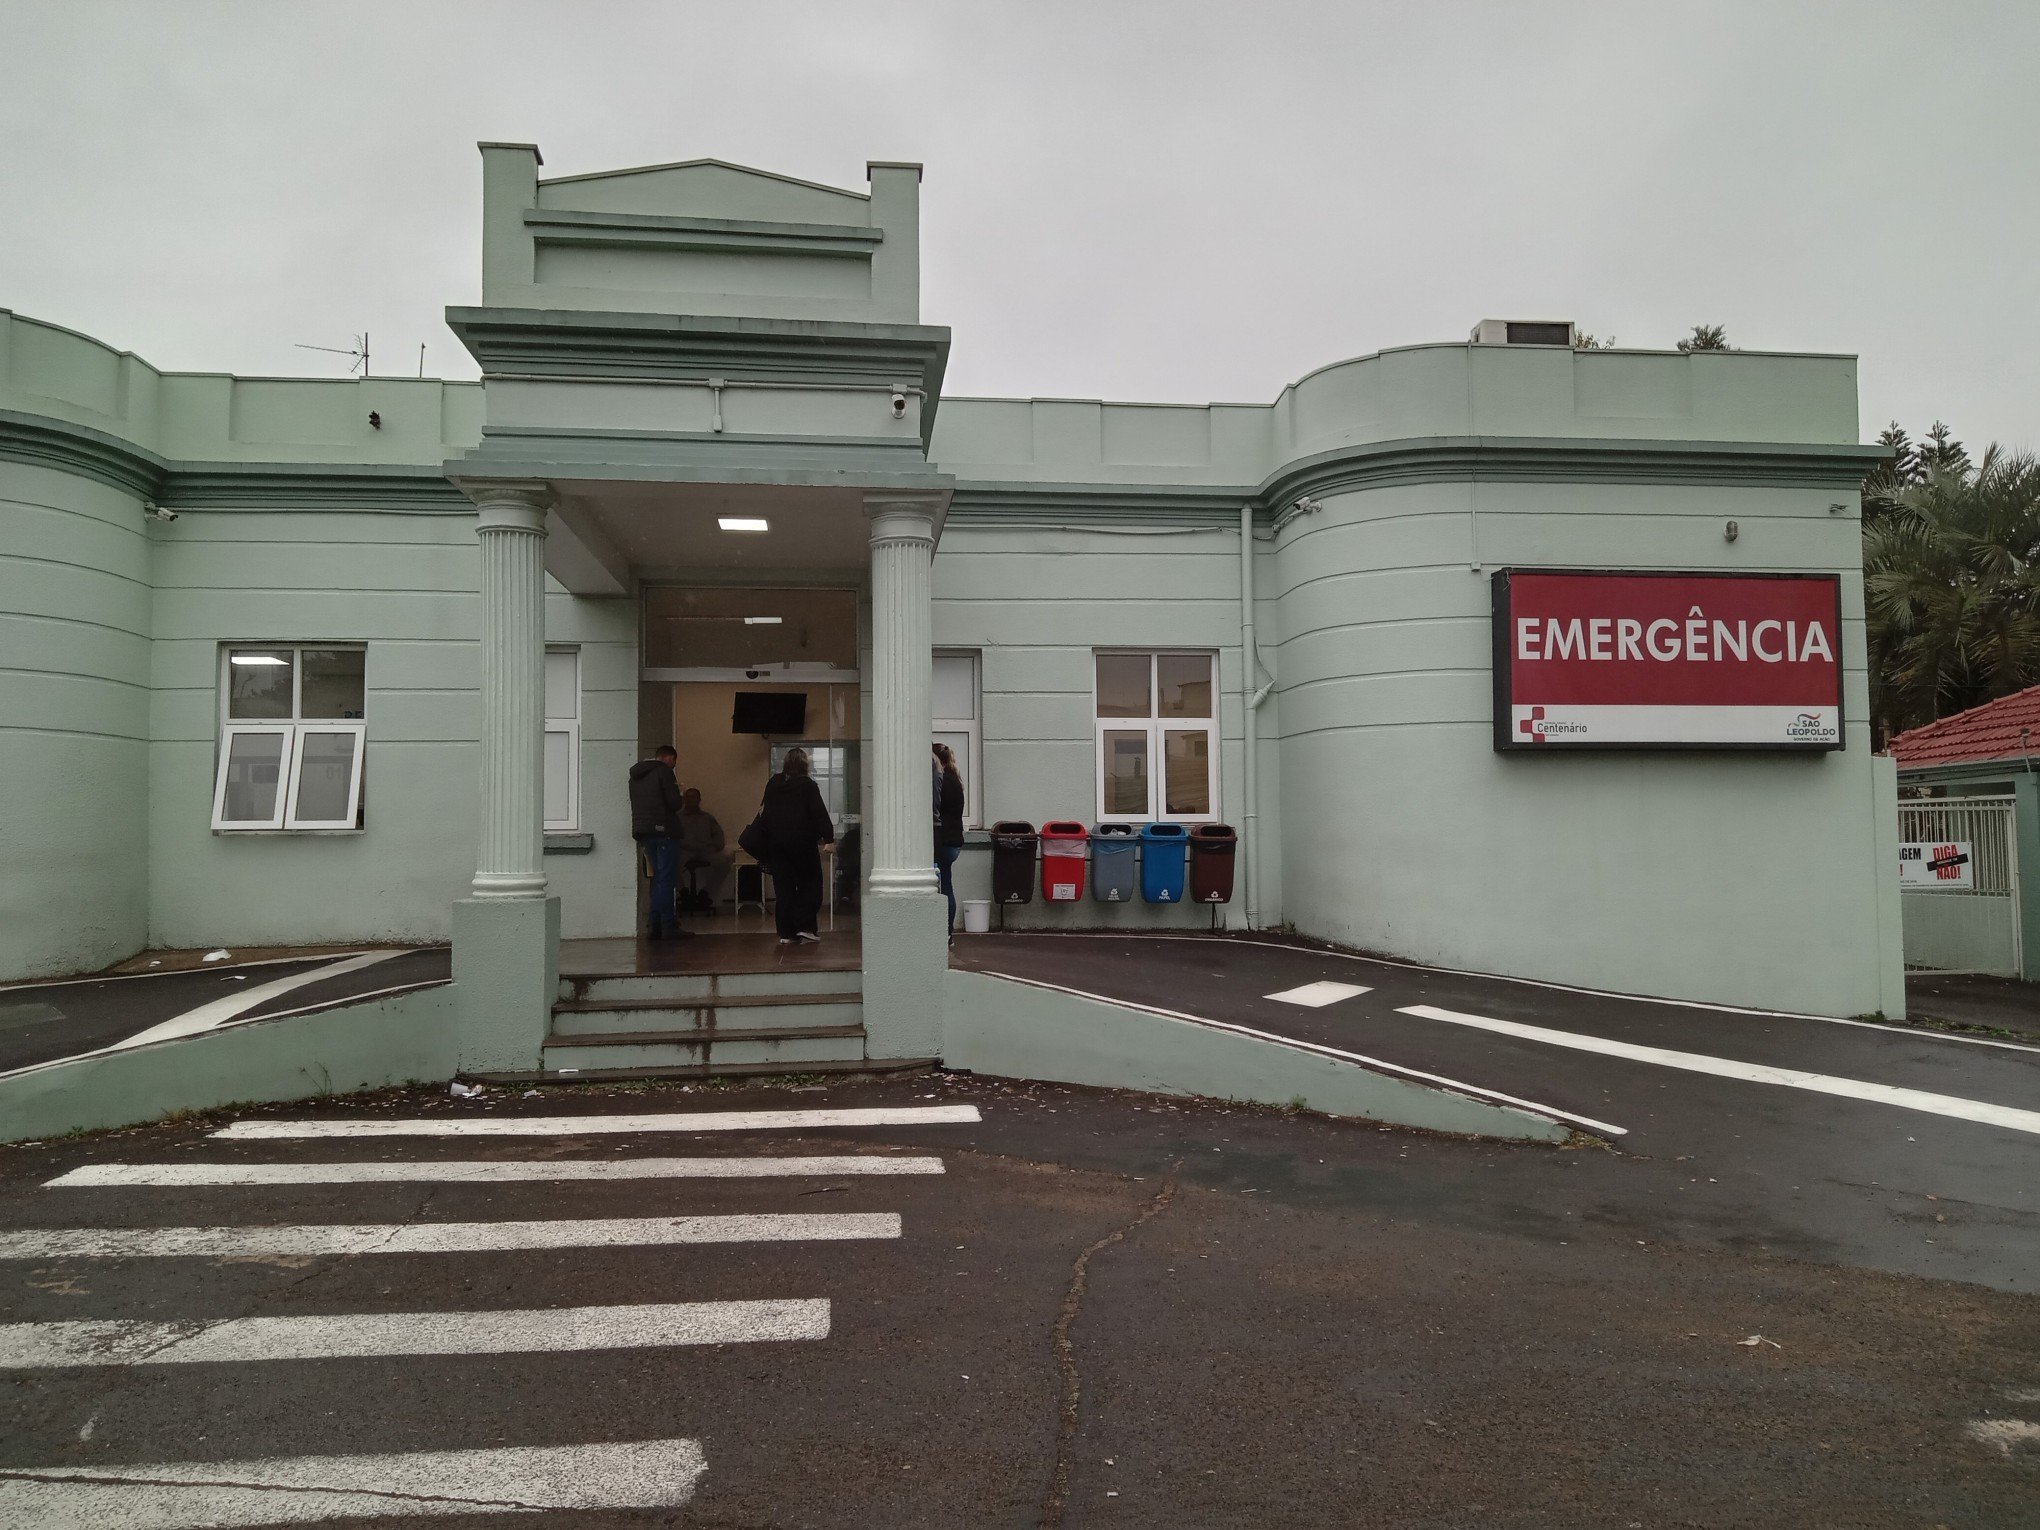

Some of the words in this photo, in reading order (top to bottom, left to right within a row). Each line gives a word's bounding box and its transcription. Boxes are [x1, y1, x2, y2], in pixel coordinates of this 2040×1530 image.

[1516, 605, 1834, 663] EMERGÊNCIA
[1537, 722, 1588, 733] Centenário
[1933, 845, 1958, 861] DIGA
[1937, 864, 1961, 880] NÃO!
